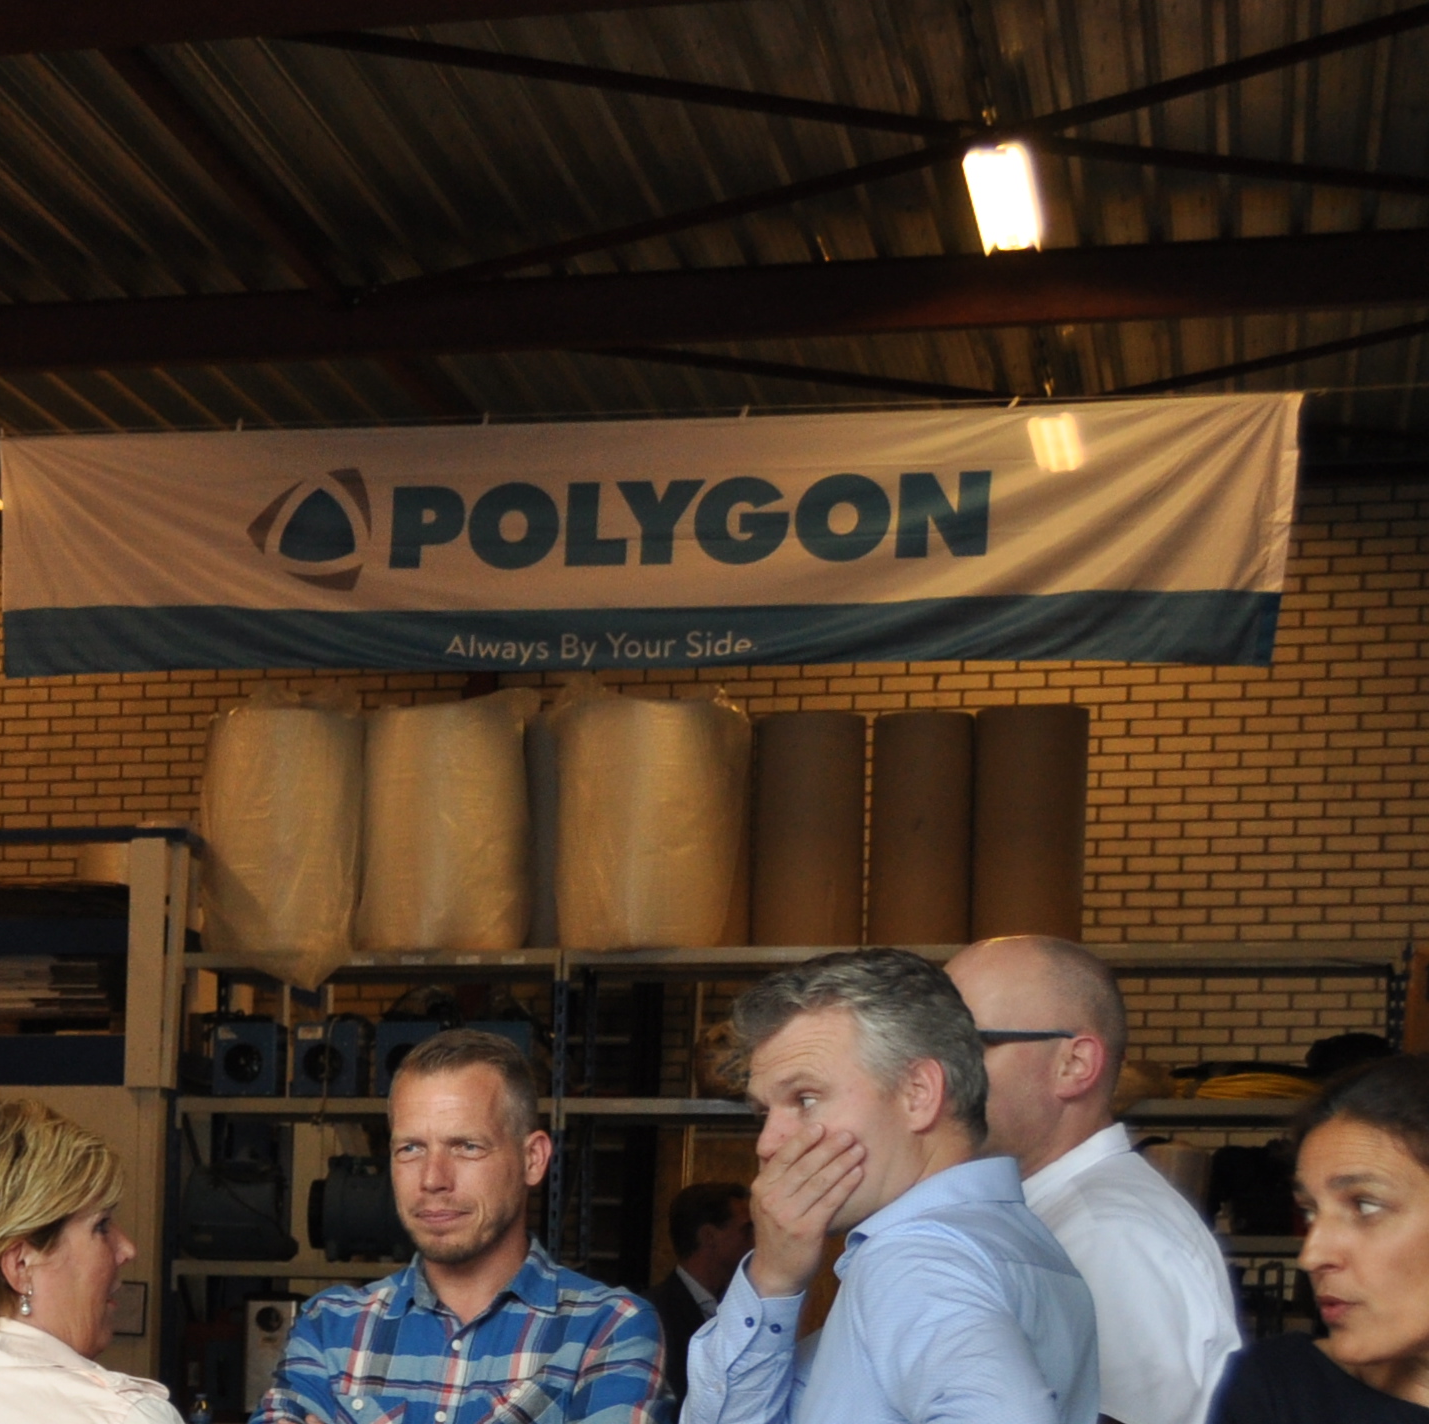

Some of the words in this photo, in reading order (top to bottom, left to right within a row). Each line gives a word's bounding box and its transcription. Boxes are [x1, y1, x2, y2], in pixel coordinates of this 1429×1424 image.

[389, 470, 991, 569] POLYGON
[445, 634, 548, 666] Always
[560, 633, 597, 666] By
[605, 632, 677, 660] Your
